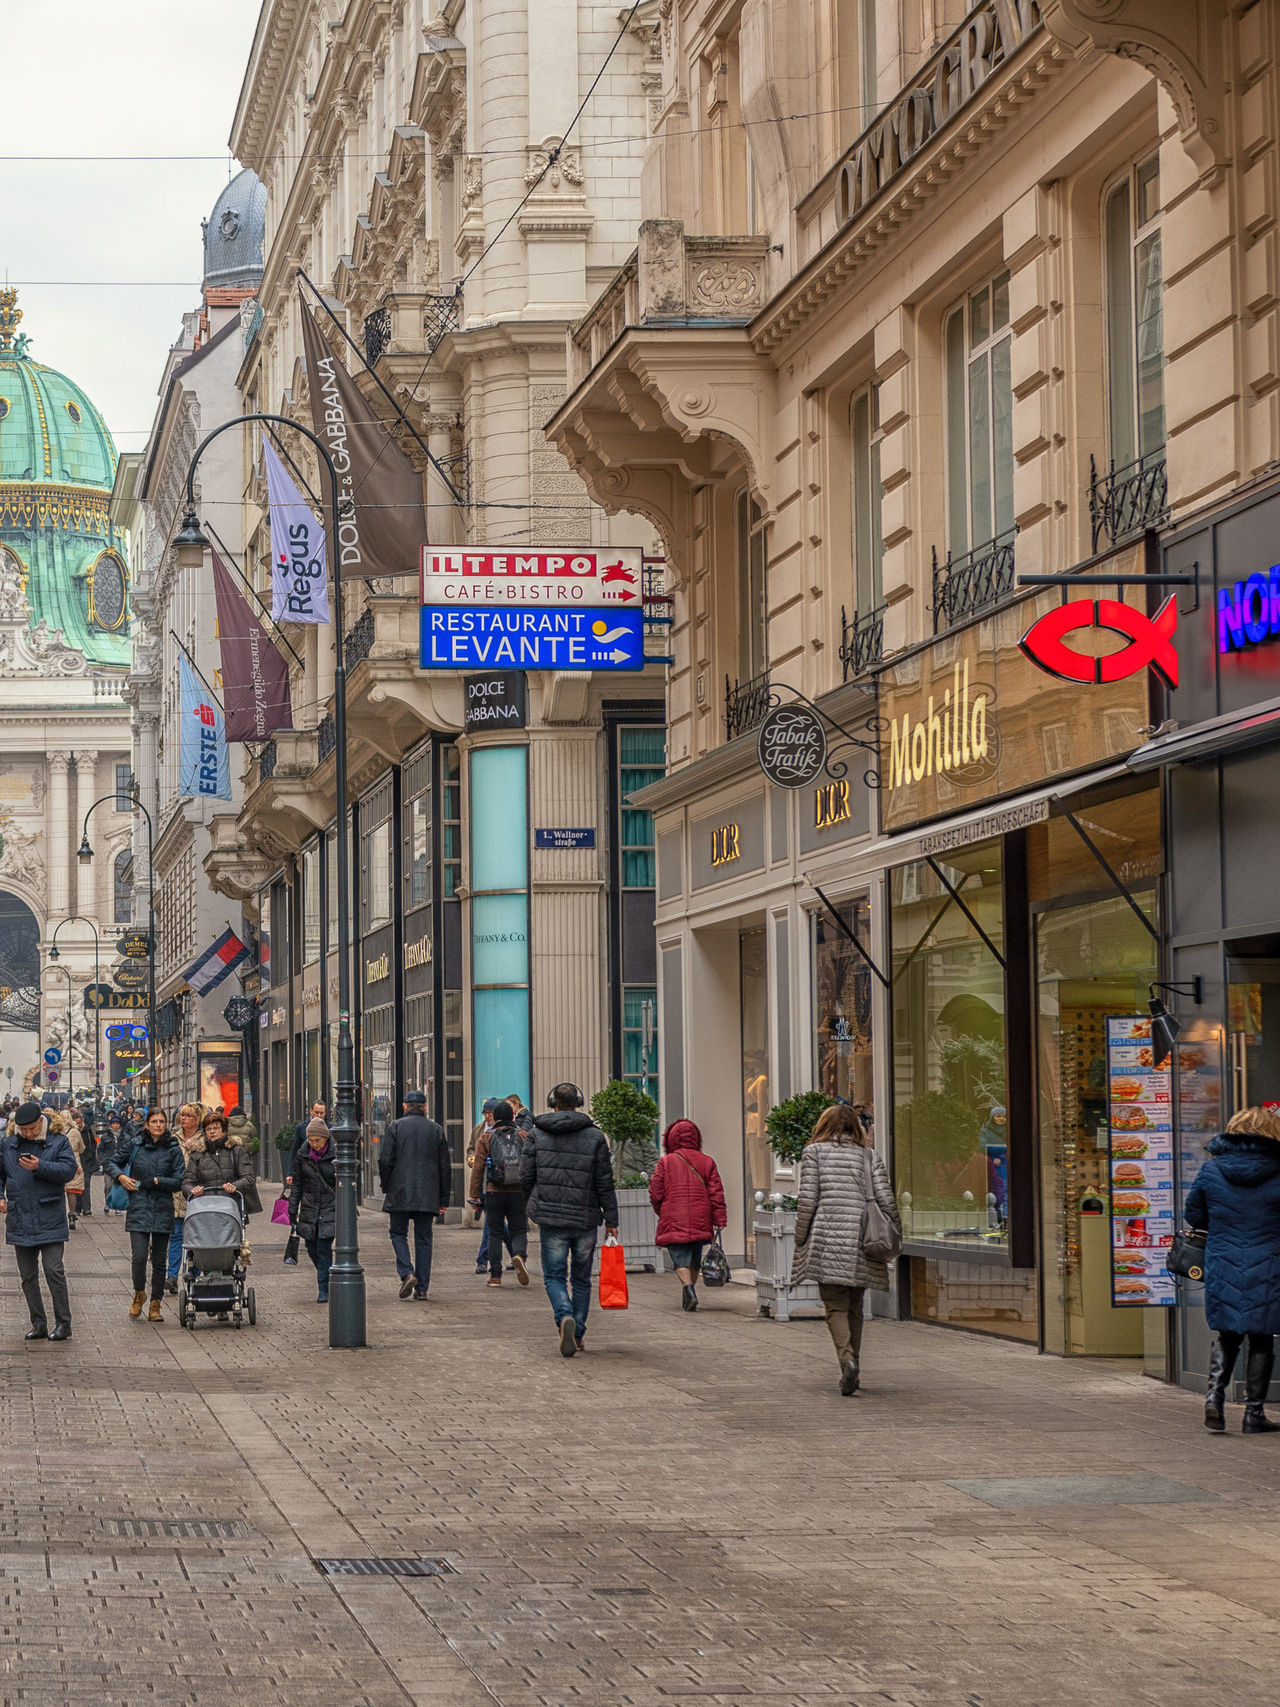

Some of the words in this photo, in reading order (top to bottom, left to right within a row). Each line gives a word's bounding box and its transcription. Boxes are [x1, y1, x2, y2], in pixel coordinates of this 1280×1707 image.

[317, 356, 352, 474] GABBANA
[342, 475, 353, 485] &
[289, 523, 323, 614] Regus
[432, 556, 460, 573] IL
[466, 556, 593, 575] TEMPO
[432, 613, 586, 632] RESTAURANT
[431, 635, 587, 663] LEVANTE
[249, 627, 264, 699] Ermenegildo
[257, 699, 268, 737] Zegna
[469, 681, 505, 697] DOLCE
[481, 697, 487, 705] &
[465, 705, 519, 723] GABBANA
[888, 656, 988, 790] Mohilla
[764, 725, 820, 747] Tabak
[200, 728, 217, 795] ERSTE
[765, 746, 820, 774] Trafik
[814, 779, 852, 829] DIOR
[553, 830, 588, 839] Wallner-
[919, 800, 1047, 855] TABAKSPEZIALITÄTENGESCHÄFT
[554, 838, 577, 847] straße
[711, 823, 740, 866] DIOR
[500, 933, 508, 942] &
